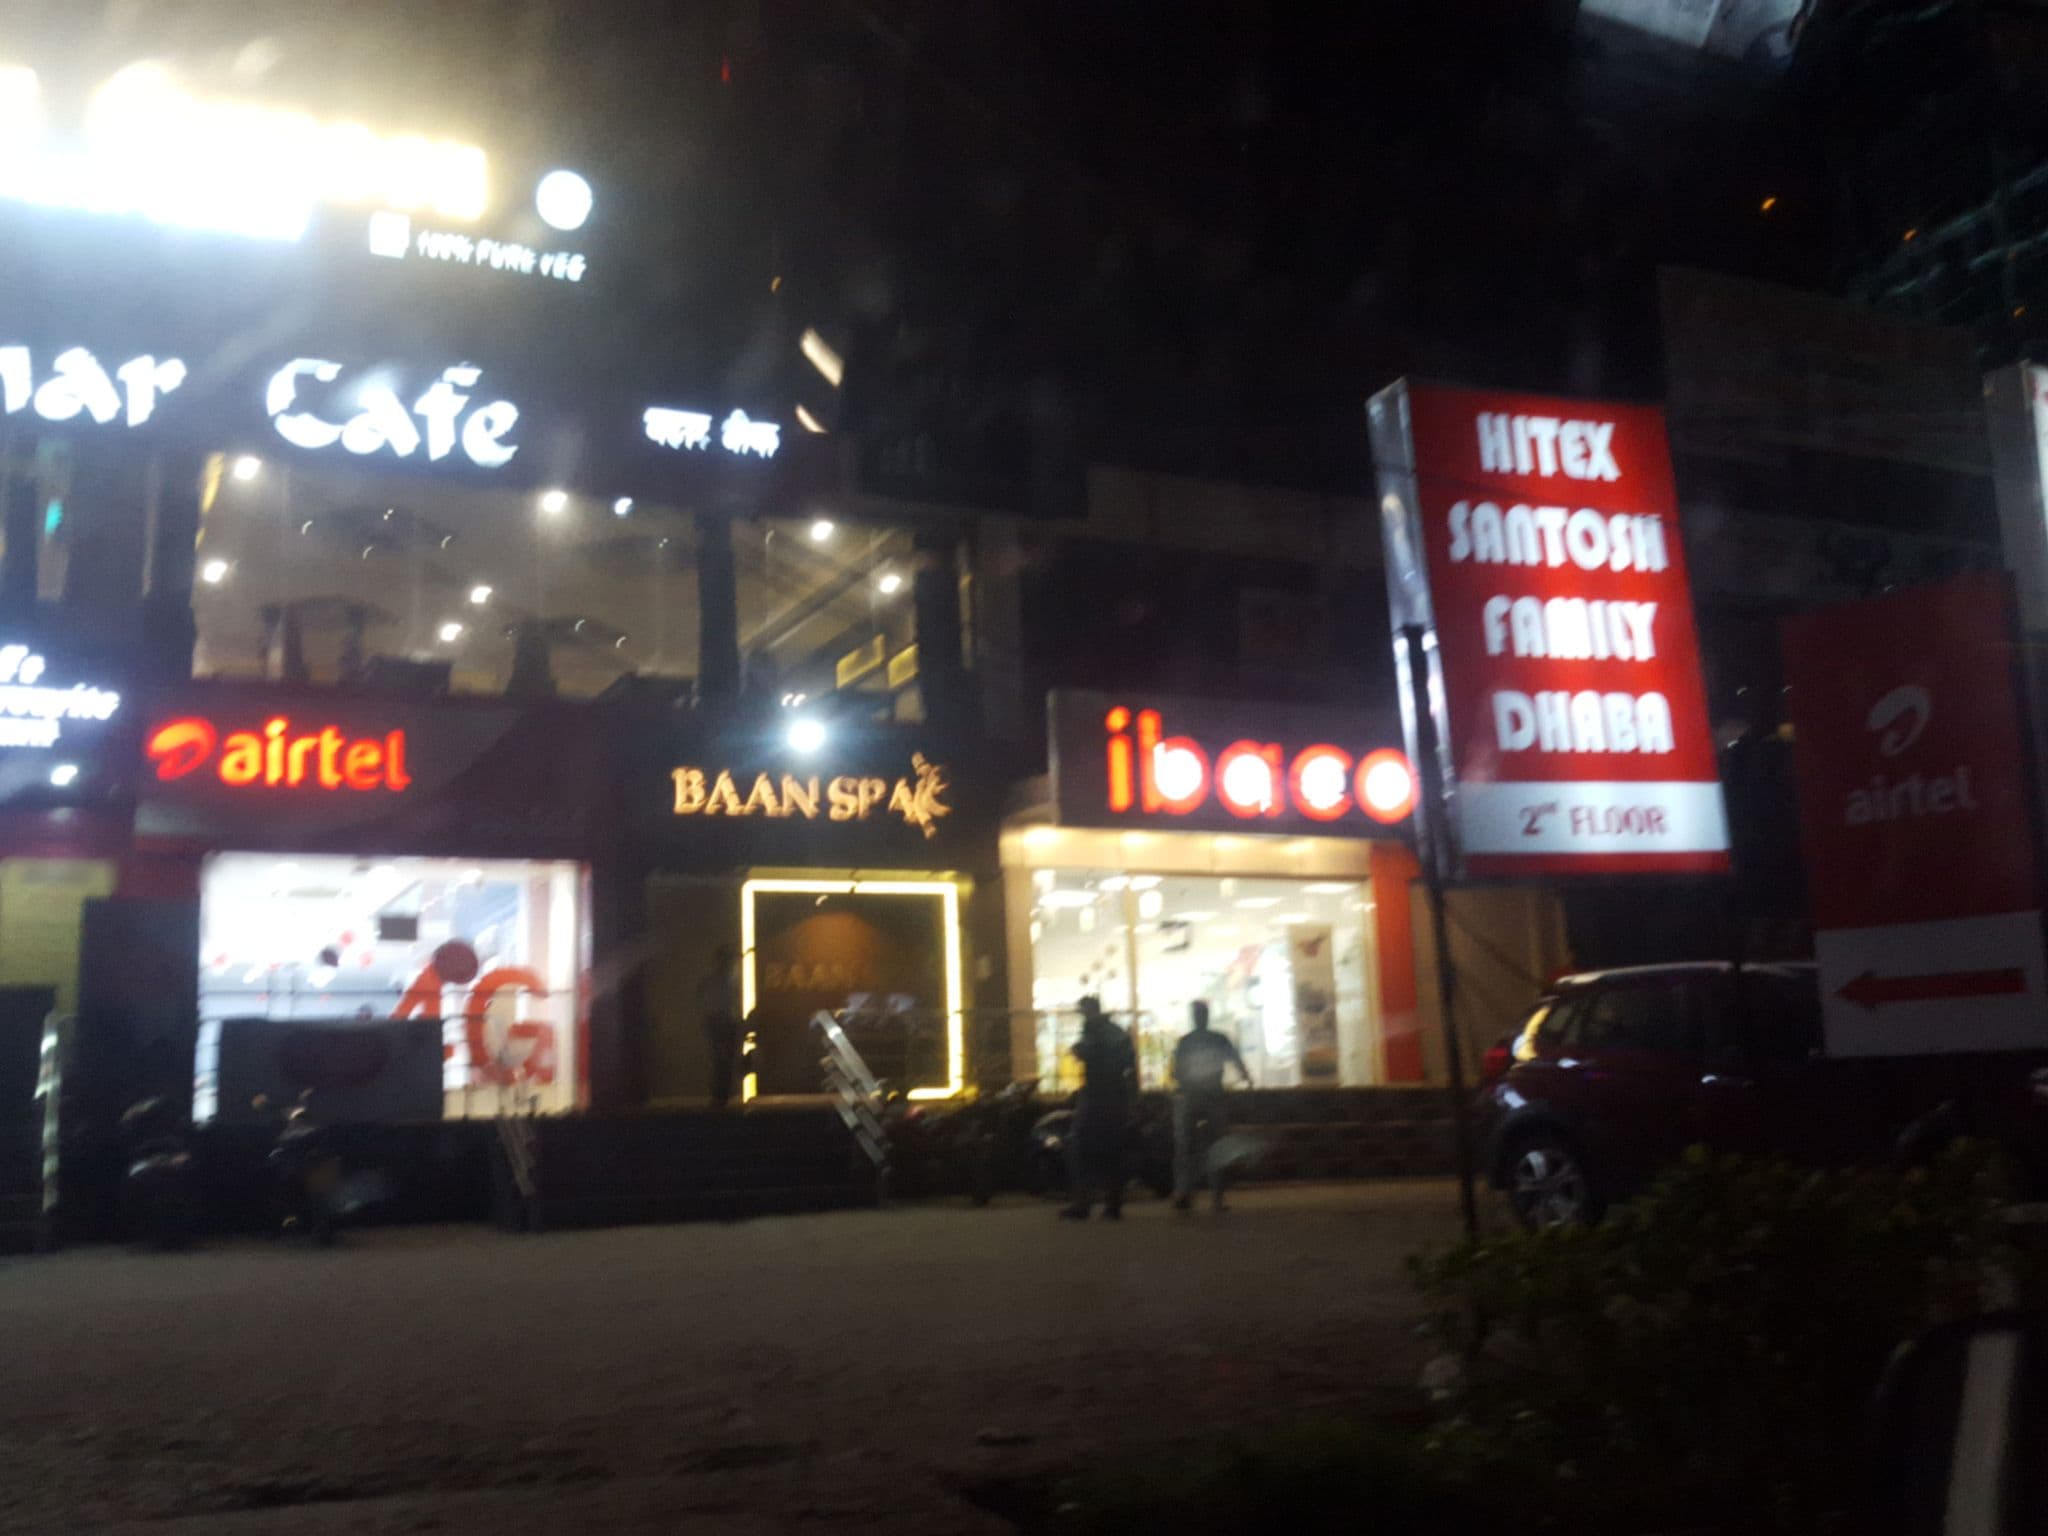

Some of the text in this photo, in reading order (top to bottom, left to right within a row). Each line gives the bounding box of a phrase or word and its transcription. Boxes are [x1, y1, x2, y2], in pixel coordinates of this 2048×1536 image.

[1476, 412, 1621, 482] HITEX
[1448, 502, 1668, 572] SANTOSH
[1483, 596, 1658, 661] FAMILY
[219, 717, 410, 791] airtel
[1492, 690, 1675, 754] DHABA
[671, 766, 820, 819] BAAN
[1104, 706, 1418, 823] ibaco
[1845, 766, 1978, 826] airtel
[1570, 806, 1667, 836] FLOOR
